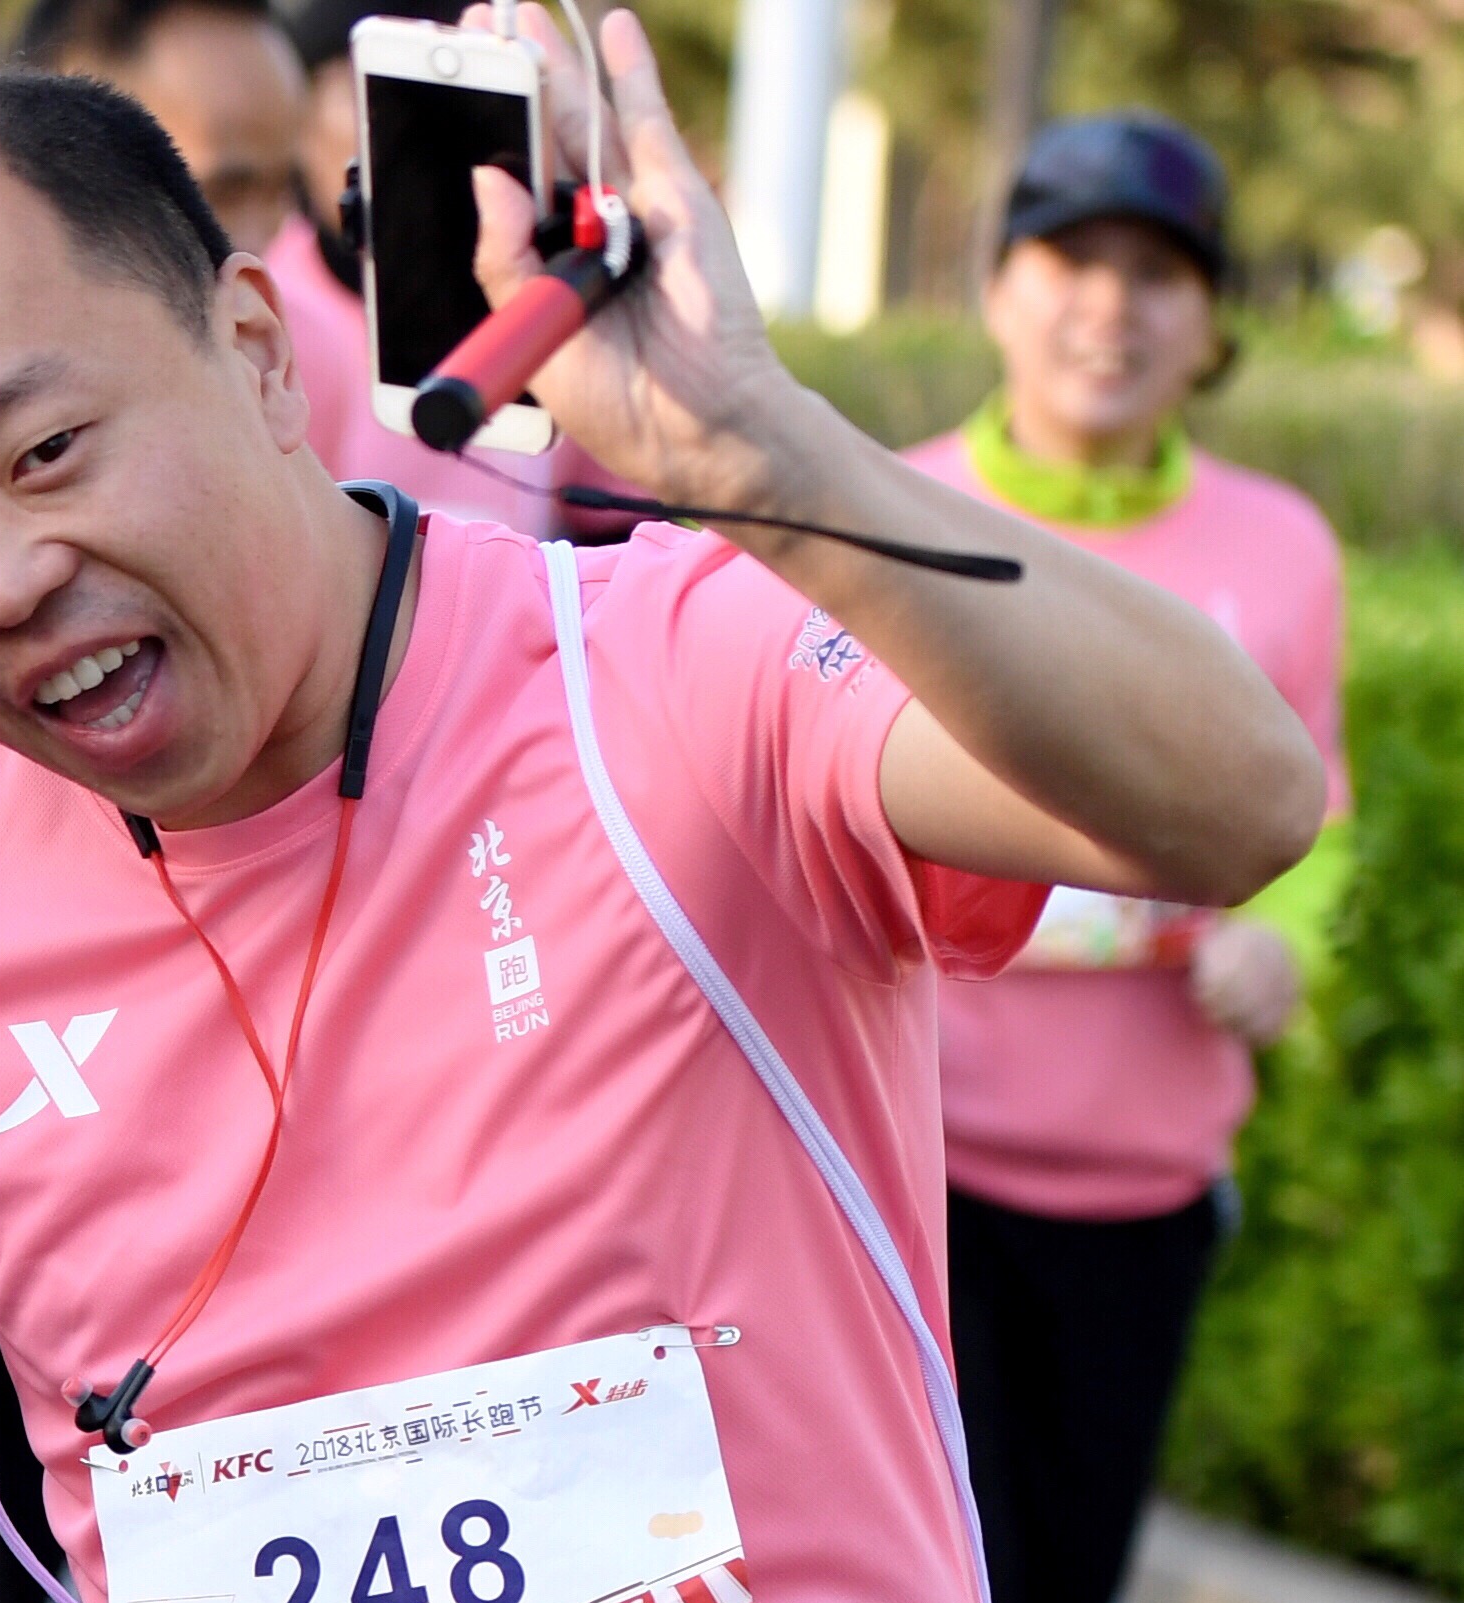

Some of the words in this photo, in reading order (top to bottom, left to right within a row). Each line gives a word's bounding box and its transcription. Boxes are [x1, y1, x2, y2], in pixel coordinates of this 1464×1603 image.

[492, 992, 545, 1022] BEIJING
[494, 1008, 551, 1044] RUN
[211, 1448, 274, 1484] KFC
